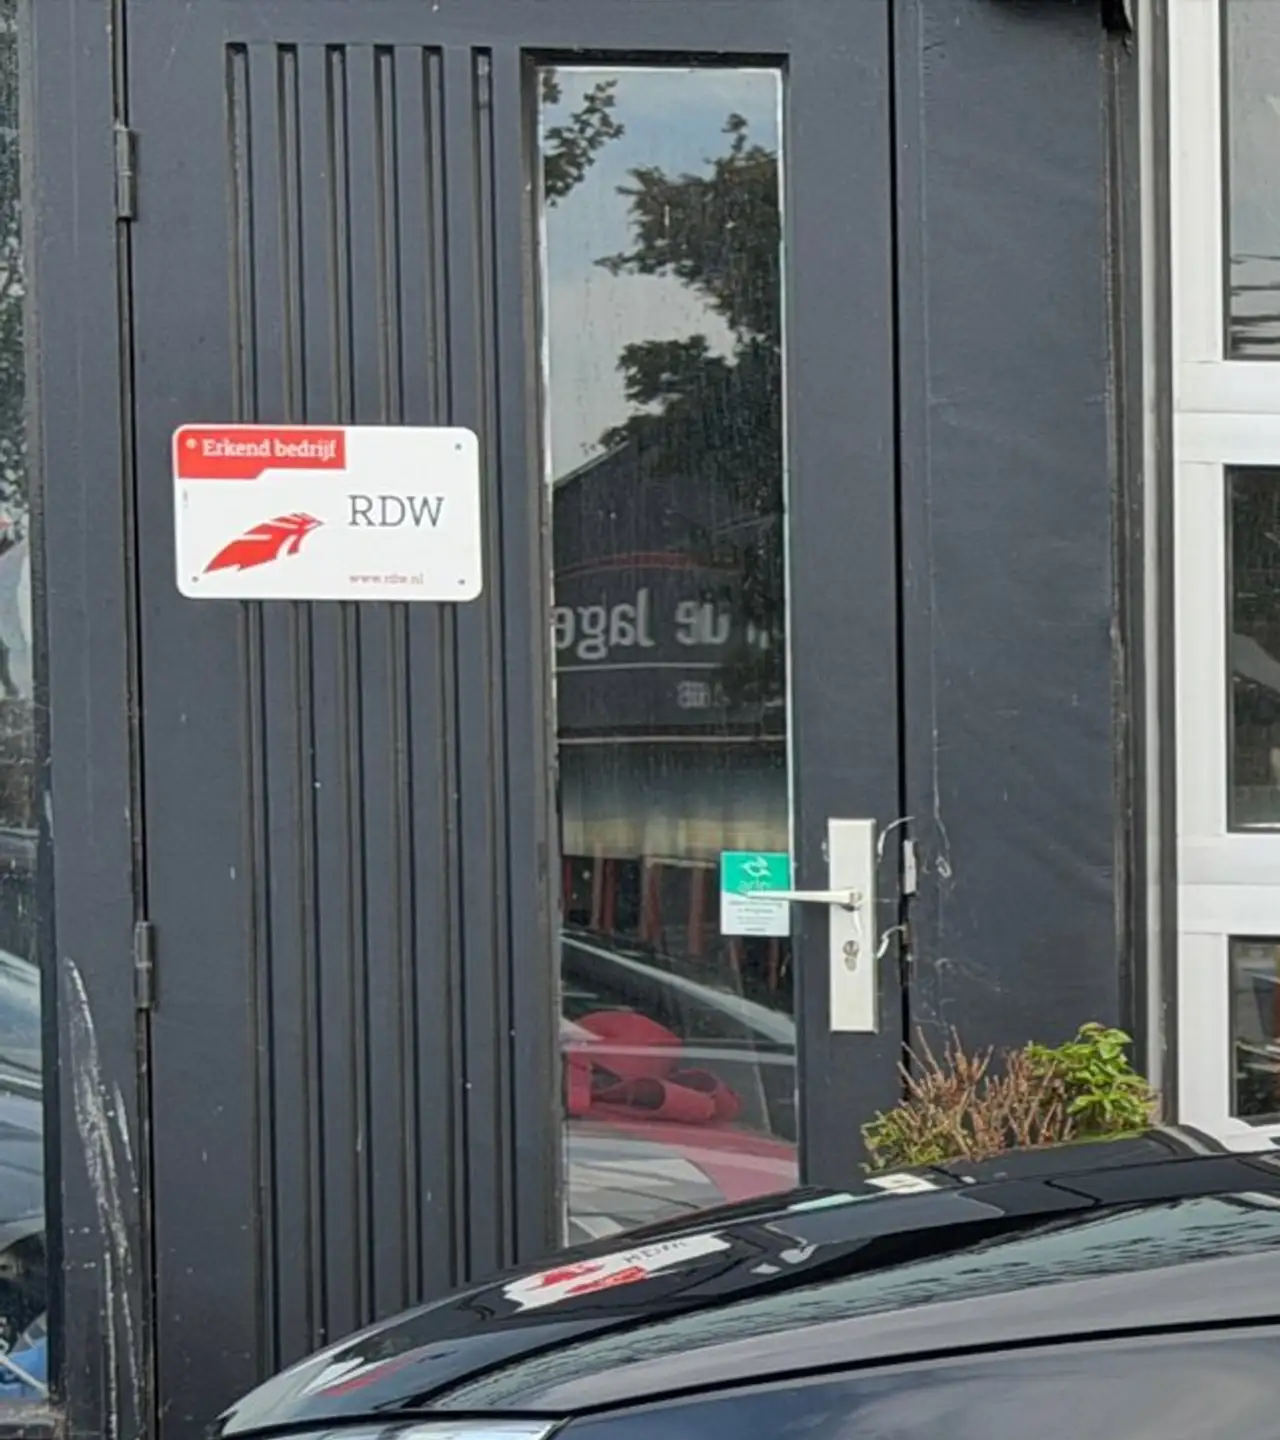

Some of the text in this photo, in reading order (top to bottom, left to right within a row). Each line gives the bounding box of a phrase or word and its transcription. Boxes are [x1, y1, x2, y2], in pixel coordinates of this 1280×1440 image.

[203, 438, 336, 462] Erkend bedrijf
[349, 495, 445, 528] RDW
